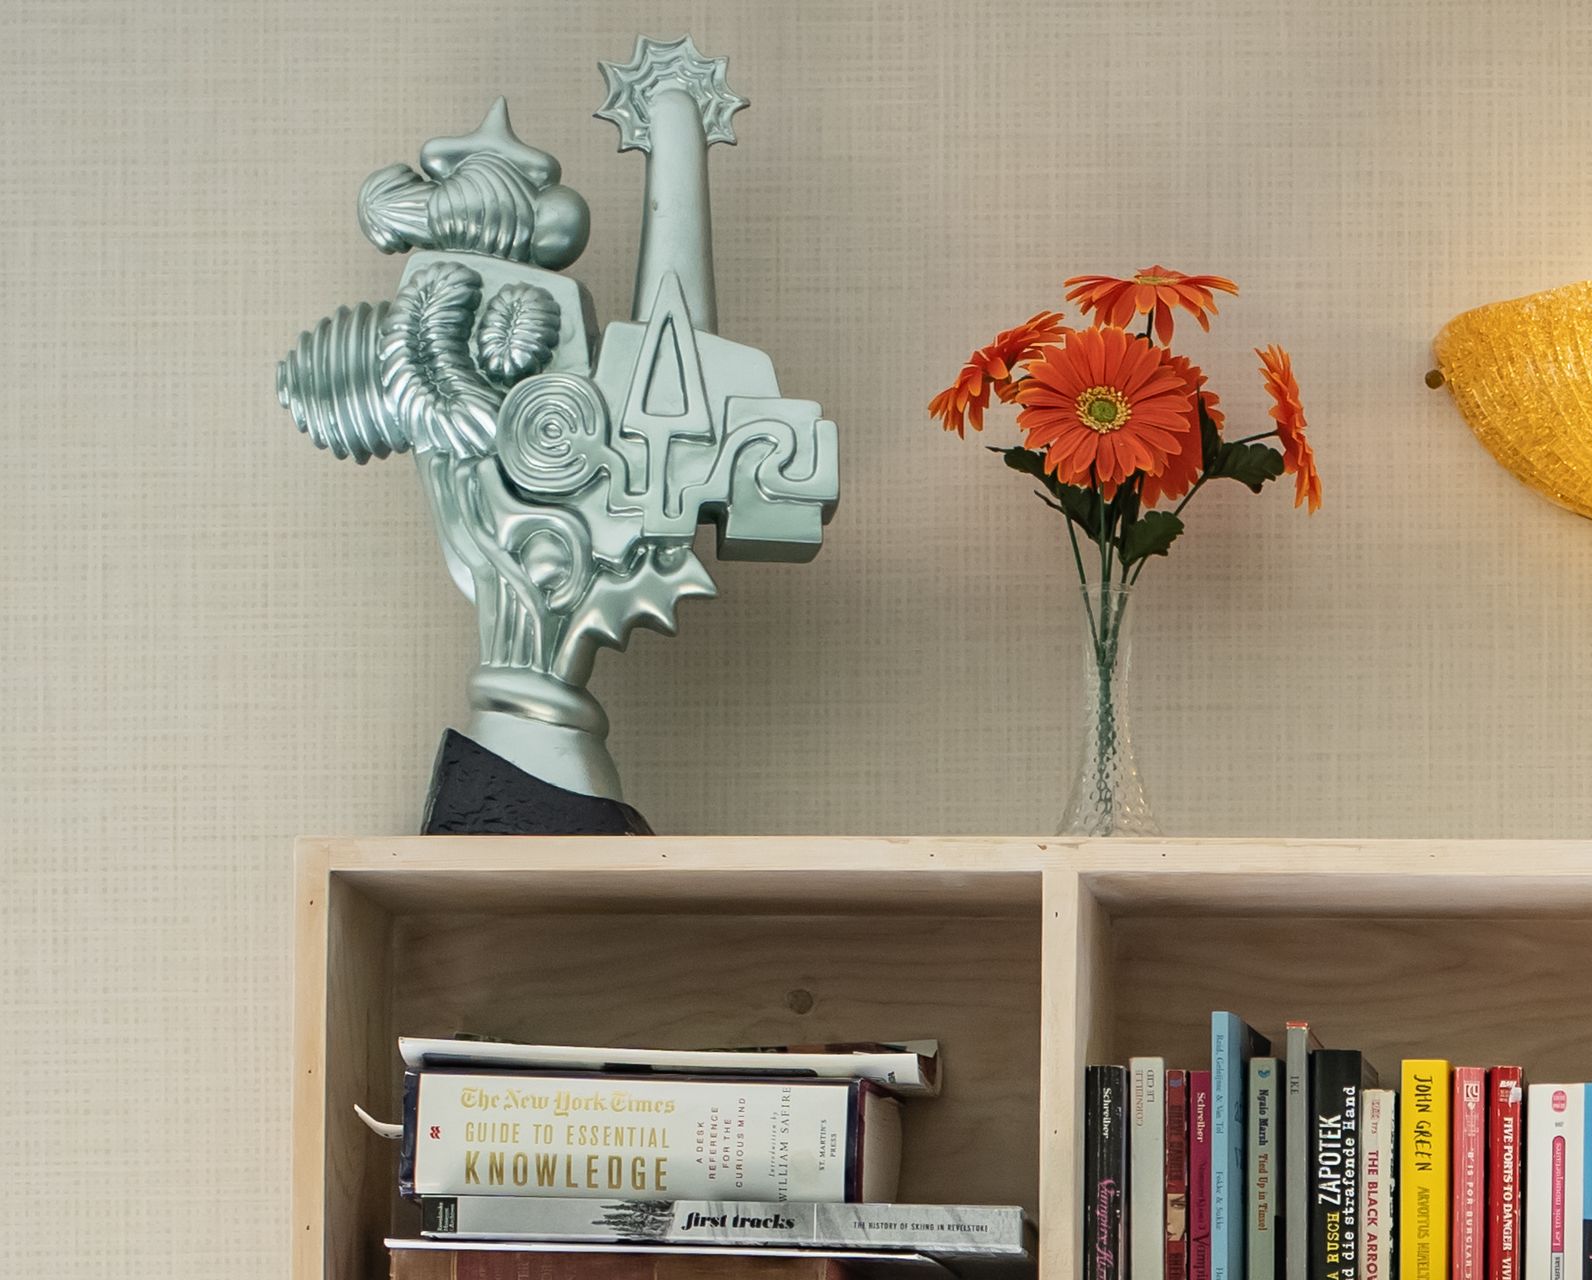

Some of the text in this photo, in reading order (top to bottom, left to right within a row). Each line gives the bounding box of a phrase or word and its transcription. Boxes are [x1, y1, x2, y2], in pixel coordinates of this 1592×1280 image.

[461, 1087, 676, 1117] The New York Times
[1135, 1070, 1145, 1127] CORNEILLE
[1146, 1069, 1155, 1103] LE CID
[1289, 1075, 1301, 1096] IKE
[1413, 1074, 1433, 1113] JOHN
[1101, 1087, 1112, 1139] Schreiber
[1196, 1091, 1207, 1143] Schreiber
[1342, 1086, 1356, 1131] Hand
[466, 1121, 670, 1148] GUIDE TO ESSENTIAL
[696, 1121, 704, 1153] DESK
[708, 1107, 719, 1179] REFERENCE
[722, 1119, 732, 1168] FOR THE
[735, 1097, 746, 1188] CURIOUS MIND
[778, 1087, 792, 1202] WILLIAM SAFIRE
[1414, 1120, 1433, 1172] GREEN
[1502, 1116, 1514, 1143] FIVE
[465, 1150, 668, 1191] KNOWLEDGE
[1257, 1089, 1270, 1232] Ngaio Marsh Tied Up in Tinsel
[1317, 1115, 1342, 1206] ZAPOTEK
[1367, 1150, 1379, 1176] THE
[1466, 1165, 1474, 1176] IS
[1502, 1145, 1514, 1182] PORTS
[1552, 1142, 1565, 1206] mousquetaires
[1342, 1137, 1355, 1226] strafende
[1466, 1182, 1474, 1205] FOR
[1502, 1185, 1514, 1201] TO
[681, 1212, 796, 1231] first tracks
[1367, 1181, 1379, 1227] BLACK
[1552, 1208, 1562, 1228] trois
[868, 1222, 897, 1230] HISTORY
[911, 1223, 935, 1231] SKIING
[1326, 1211, 1340, 1263] RUSCH
[1342, 1230, 1355, 1261] die
[1465, 1211, 1474, 1267] BURGLAR
[1501, 1203, 1513, 1251] DANGER
[1552, 1230, 1562, 1247] Les
